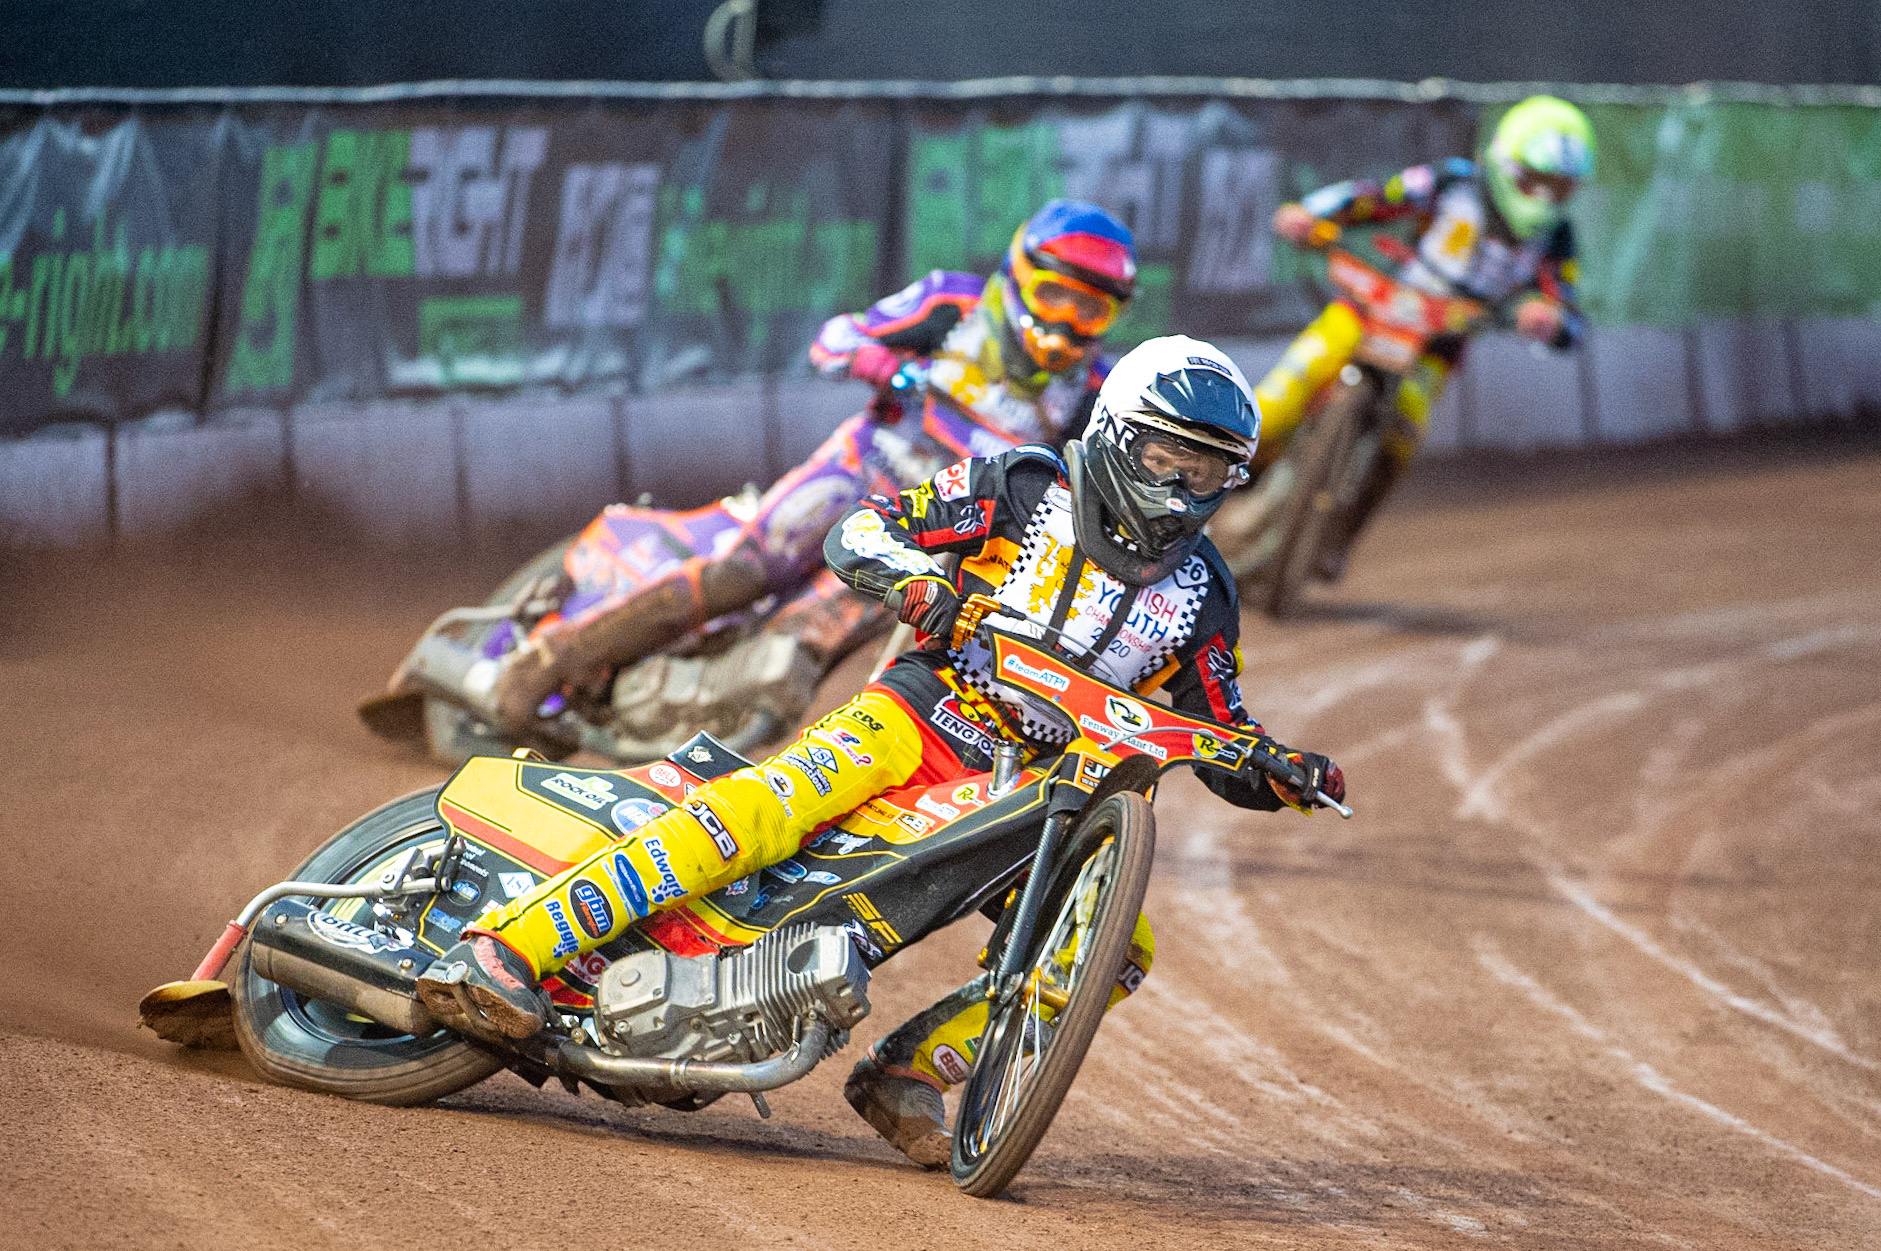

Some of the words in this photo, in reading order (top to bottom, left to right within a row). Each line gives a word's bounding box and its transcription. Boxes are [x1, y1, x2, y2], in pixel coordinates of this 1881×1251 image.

[1091, 627, 1131, 658] 220
[687, 802, 737, 860] JCB
[645, 839, 689, 897] Edward
[545, 900, 579, 953] Reggie
[575, 885, 611, 932] gbm
